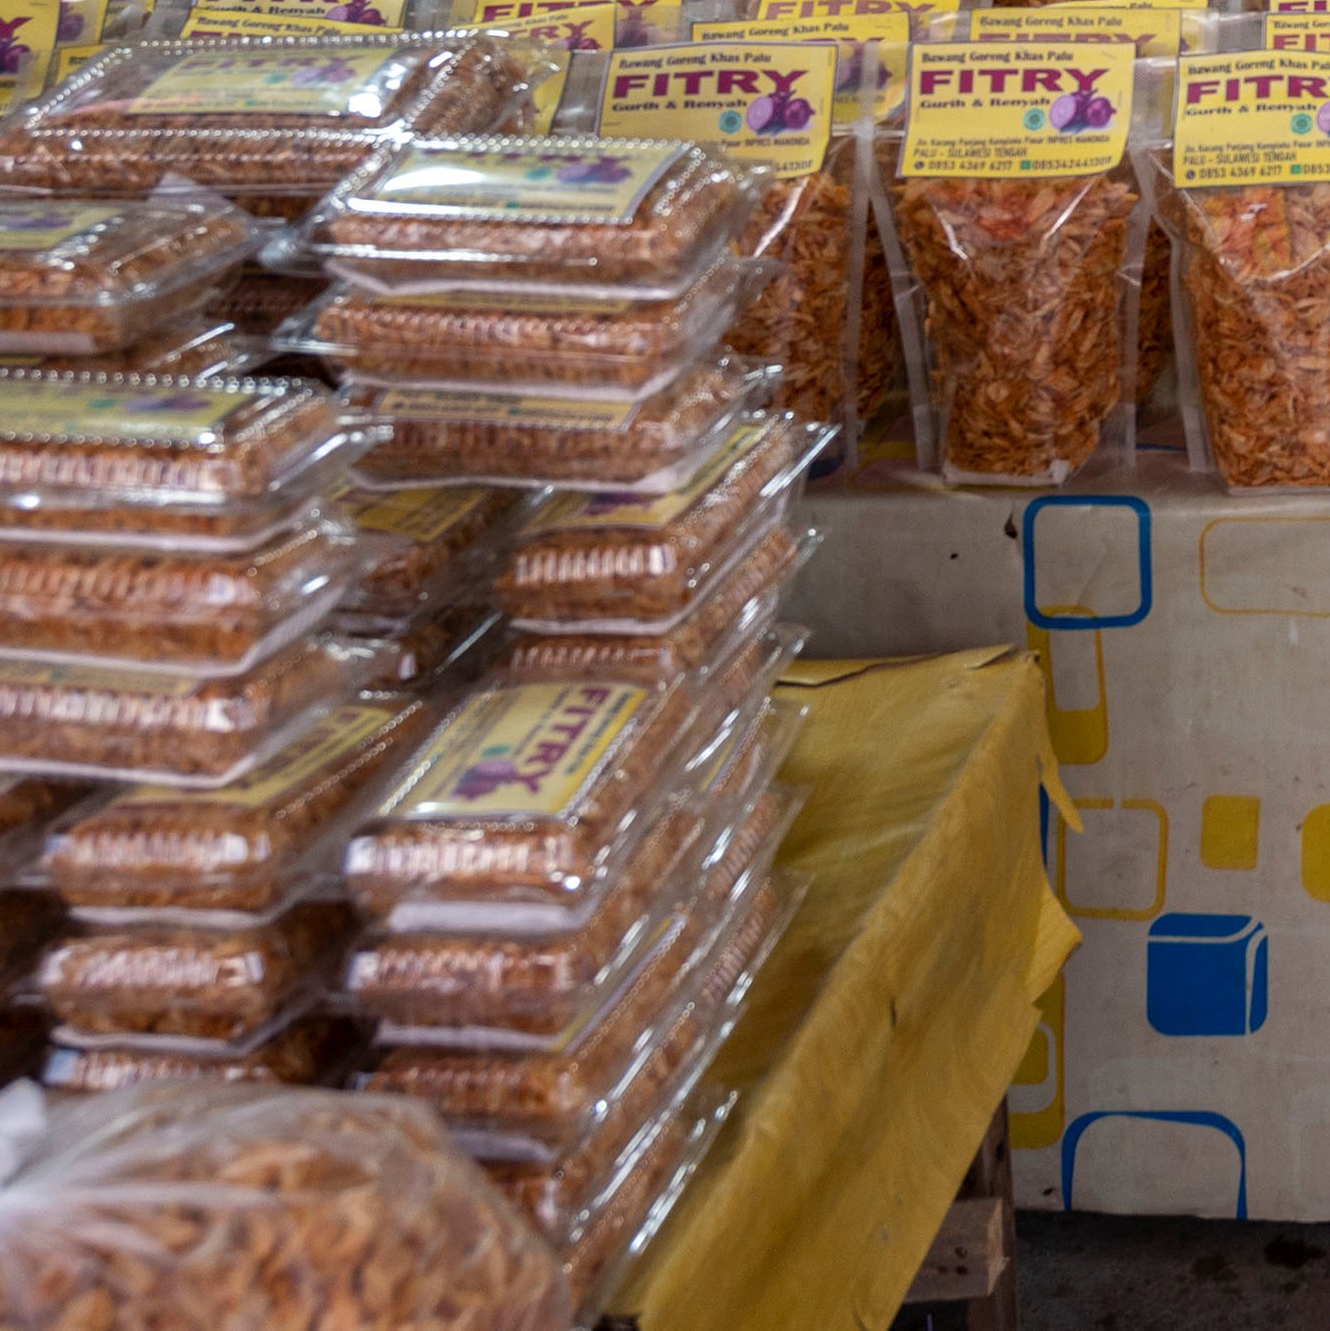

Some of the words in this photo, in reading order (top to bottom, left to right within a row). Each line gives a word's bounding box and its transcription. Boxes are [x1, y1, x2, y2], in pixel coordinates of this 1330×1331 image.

[618, 57, 662, 70] Bawang
[666, 55, 707, 67] Goreng
[711, 53, 741, 64] Khas
[744, 52, 772, 63] Palu
[921, 52, 966, 65] Bawang
[970, 51, 1011, 63] Goreng
[1015, 50, 1044, 61] Khas
[1048, 50, 1074, 61] Palu
[1188, 62, 1231, 75] Bawang
[1235, 61, 1275, 72] Goreng
[1279, 59, 1307, 69] Khas
[612, 68, 810, 99] FITRY
[918, 67, 1110, 95] FITRY
[520, 688, 611, 793] FITRY
